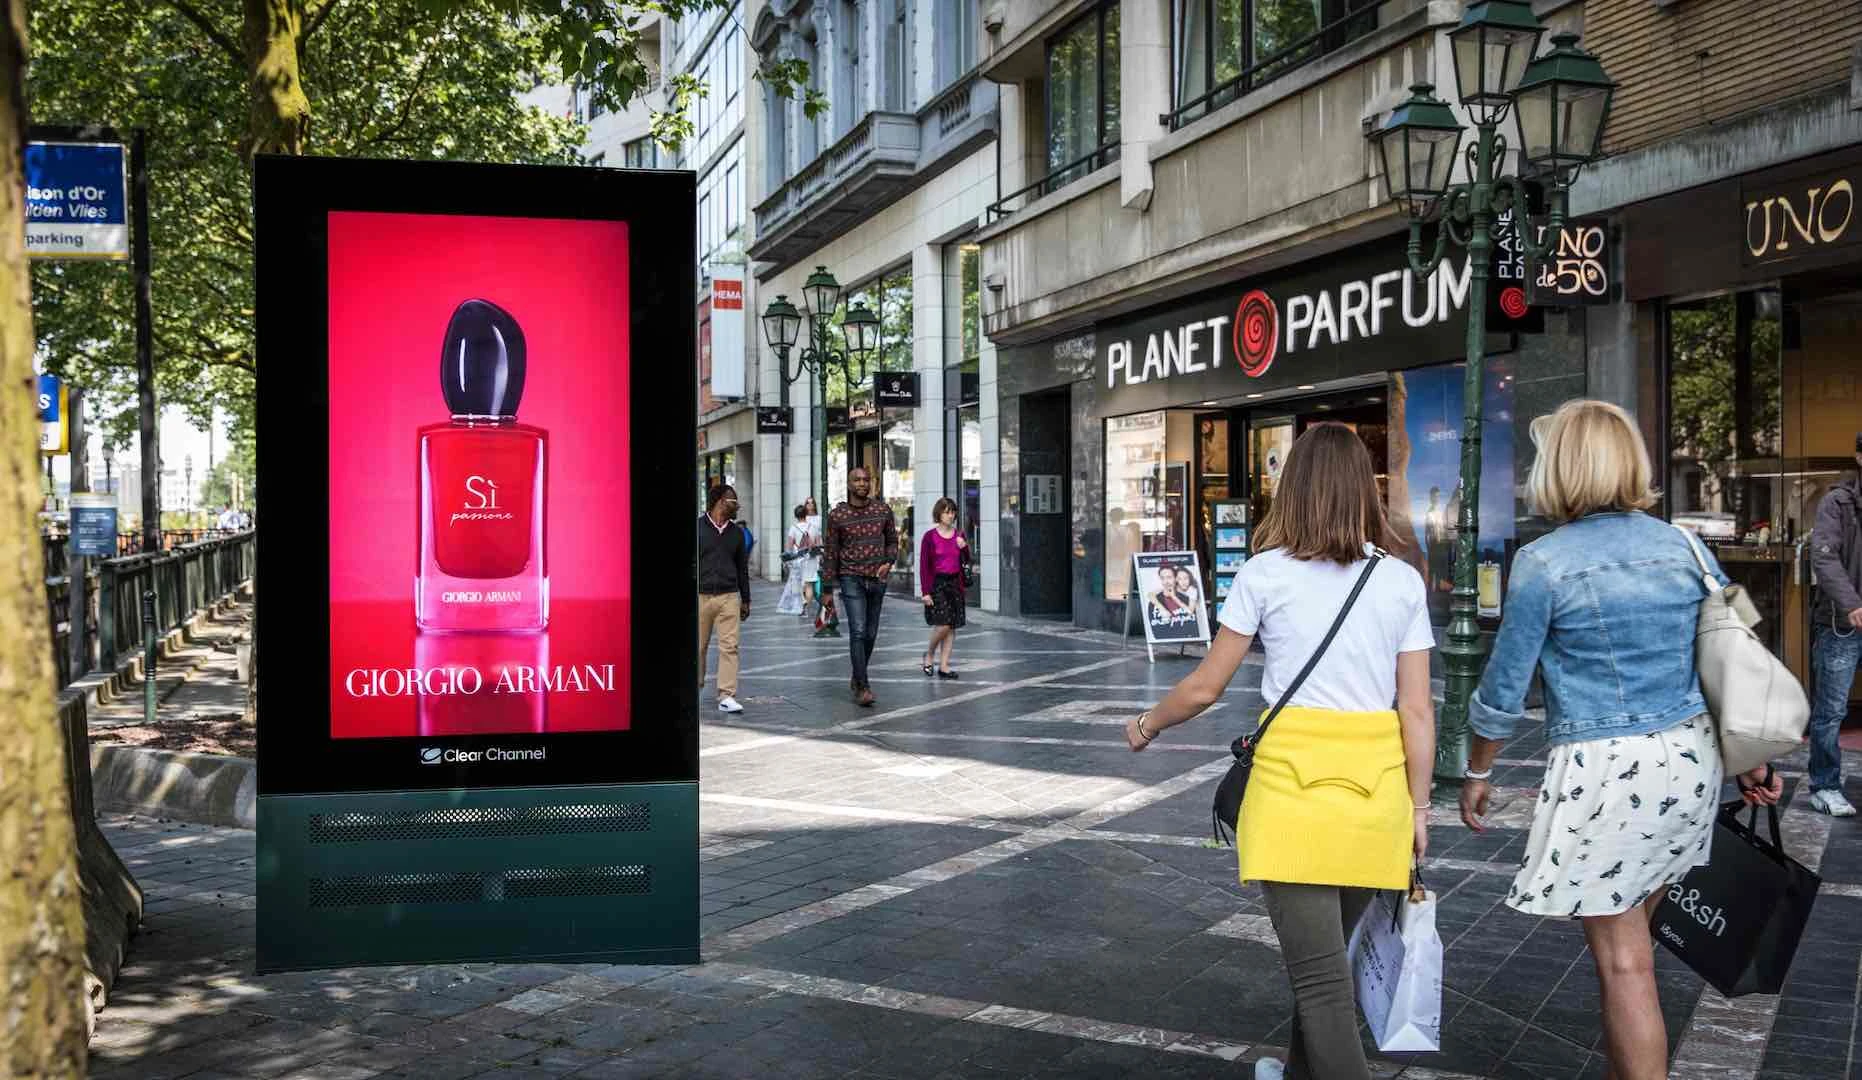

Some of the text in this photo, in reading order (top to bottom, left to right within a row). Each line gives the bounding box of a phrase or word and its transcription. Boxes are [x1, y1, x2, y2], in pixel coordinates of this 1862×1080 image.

[26, 185, 107, 201] ison d'Or
[25, 202, 108, 219] lden Vlies
[1746, 179, 1854, 257] UNO
[25, 232, 84, 247] parking
[1498, 208, 1512, 278] PLANE
[714, 290, 742, 301] HEMA
[1107, 254, 1472, 389] PLANET PARFUM
[464, 475, 501, 510] Sì
[442, 591, 522, 604] GIORGIO ARMANI
[345, 664, 617, 698] GIORGIO ARMANI
[444, 746, 546, 763] Clear Channel
[1667, 883, 1727, 937] a&sh
